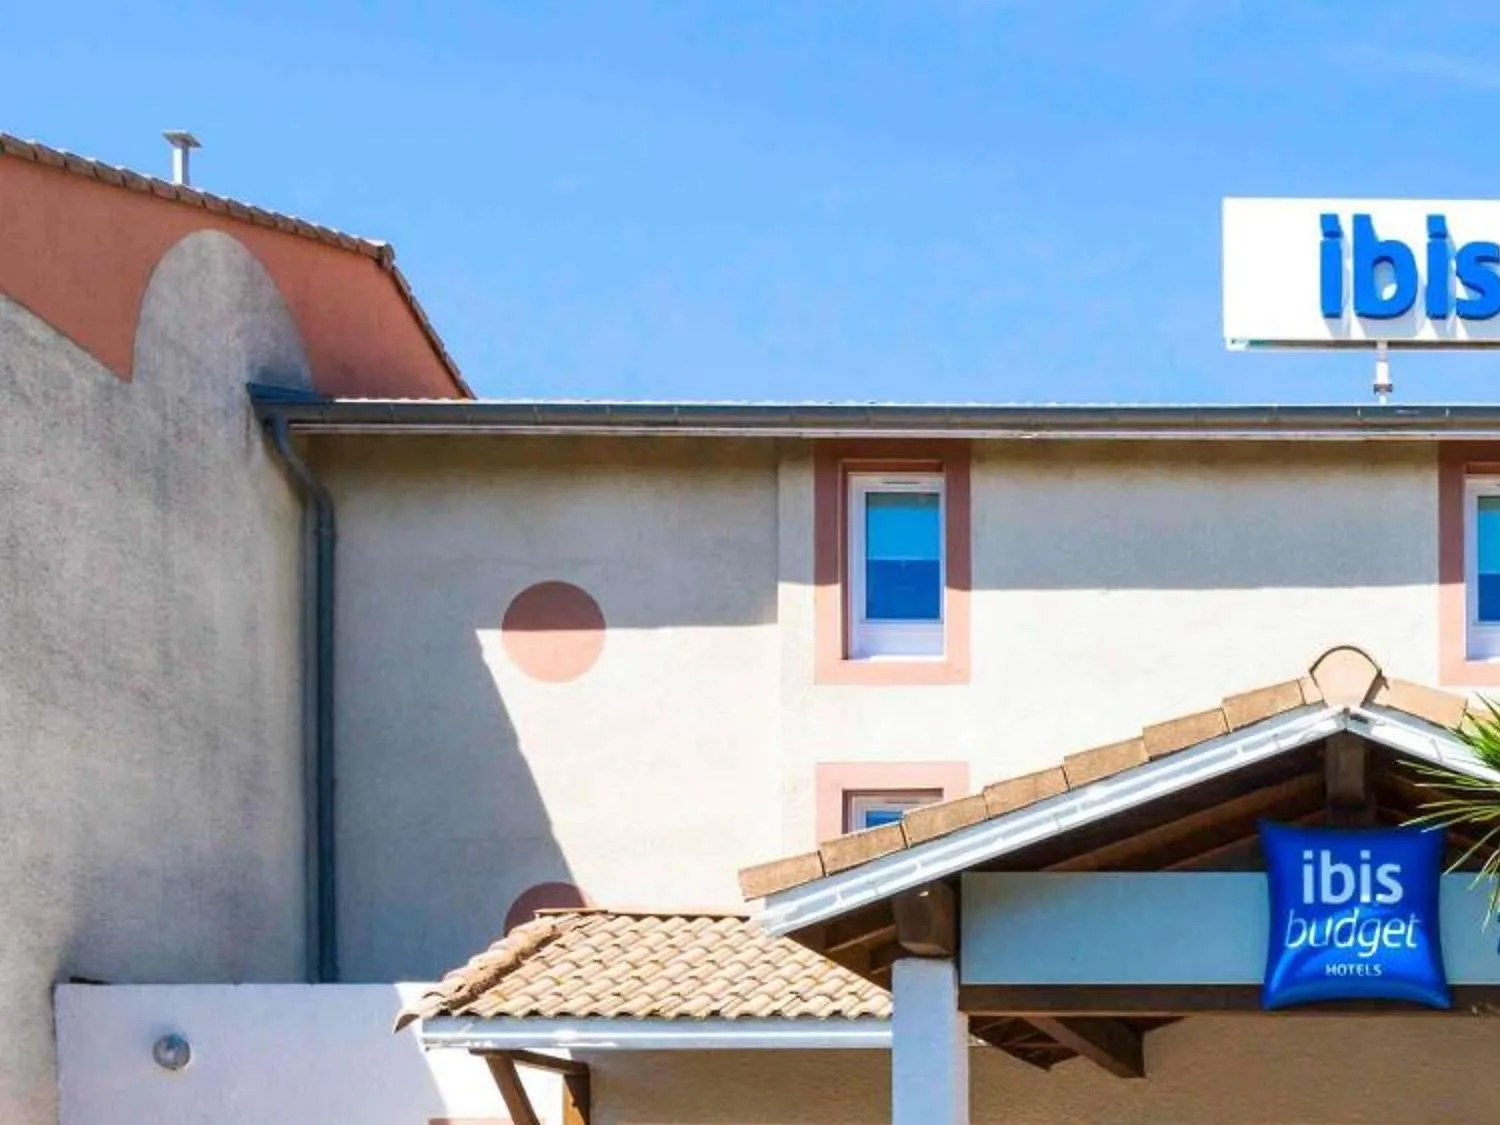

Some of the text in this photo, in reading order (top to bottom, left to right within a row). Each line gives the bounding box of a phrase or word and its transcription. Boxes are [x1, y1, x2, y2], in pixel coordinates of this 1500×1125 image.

[1303, 849, 1404, 905] ibis
[1284, 907, 1422, 958] budget
[1325, 962, 1383, 977] HOTELS
